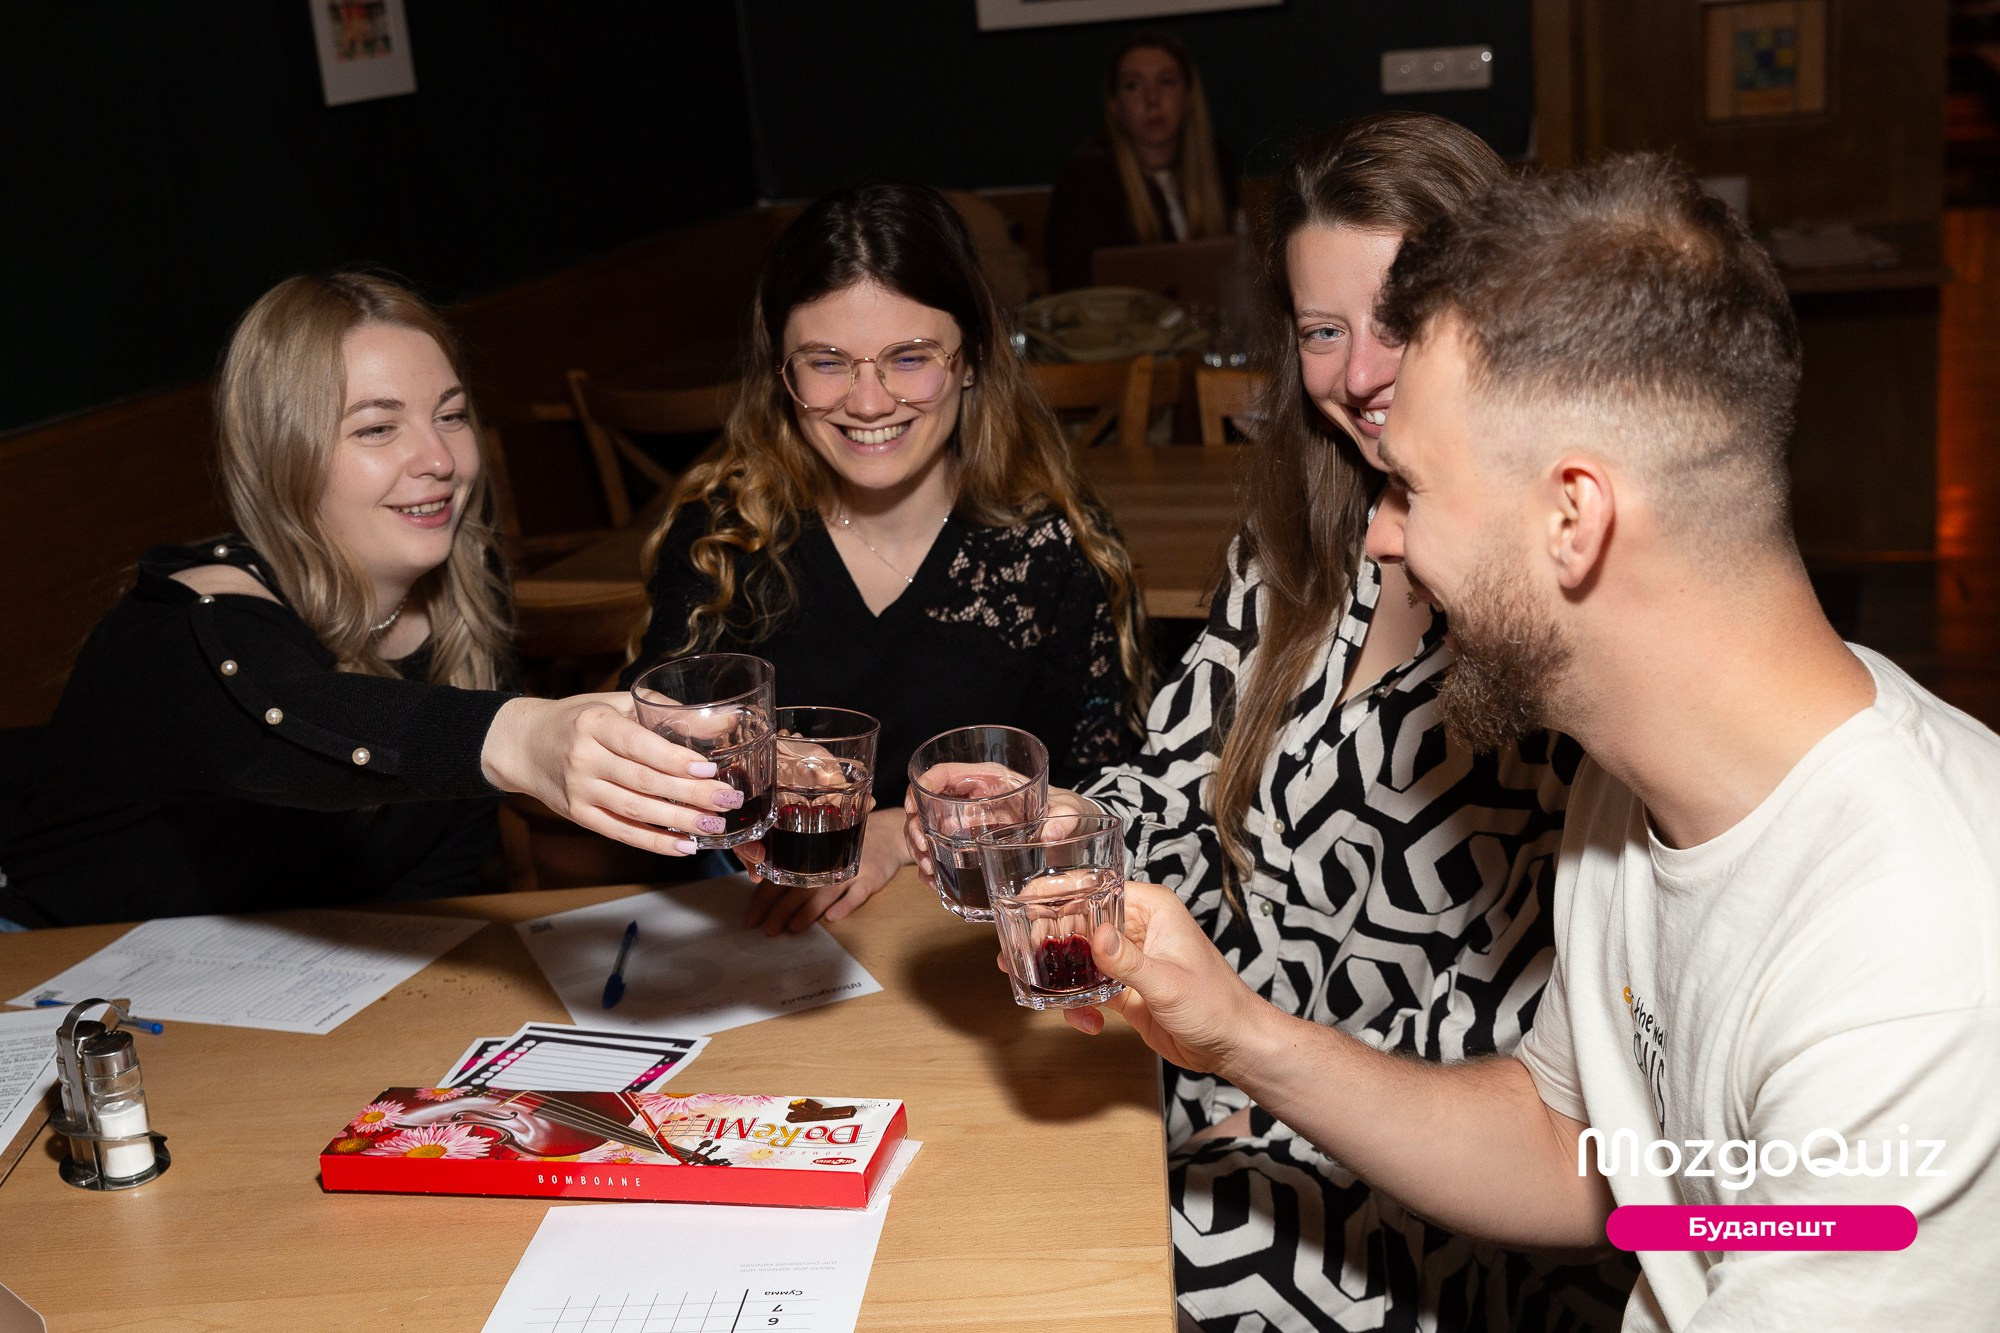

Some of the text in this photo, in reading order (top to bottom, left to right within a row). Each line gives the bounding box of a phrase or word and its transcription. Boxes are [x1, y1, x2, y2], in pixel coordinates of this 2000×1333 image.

[1634, 996, 1654, 1033] the
[537, 1174, 641, 1187] BOMBOANE
[772, 1304, 783, 1312] 7
[767, 1317, 779, 1326] 6
